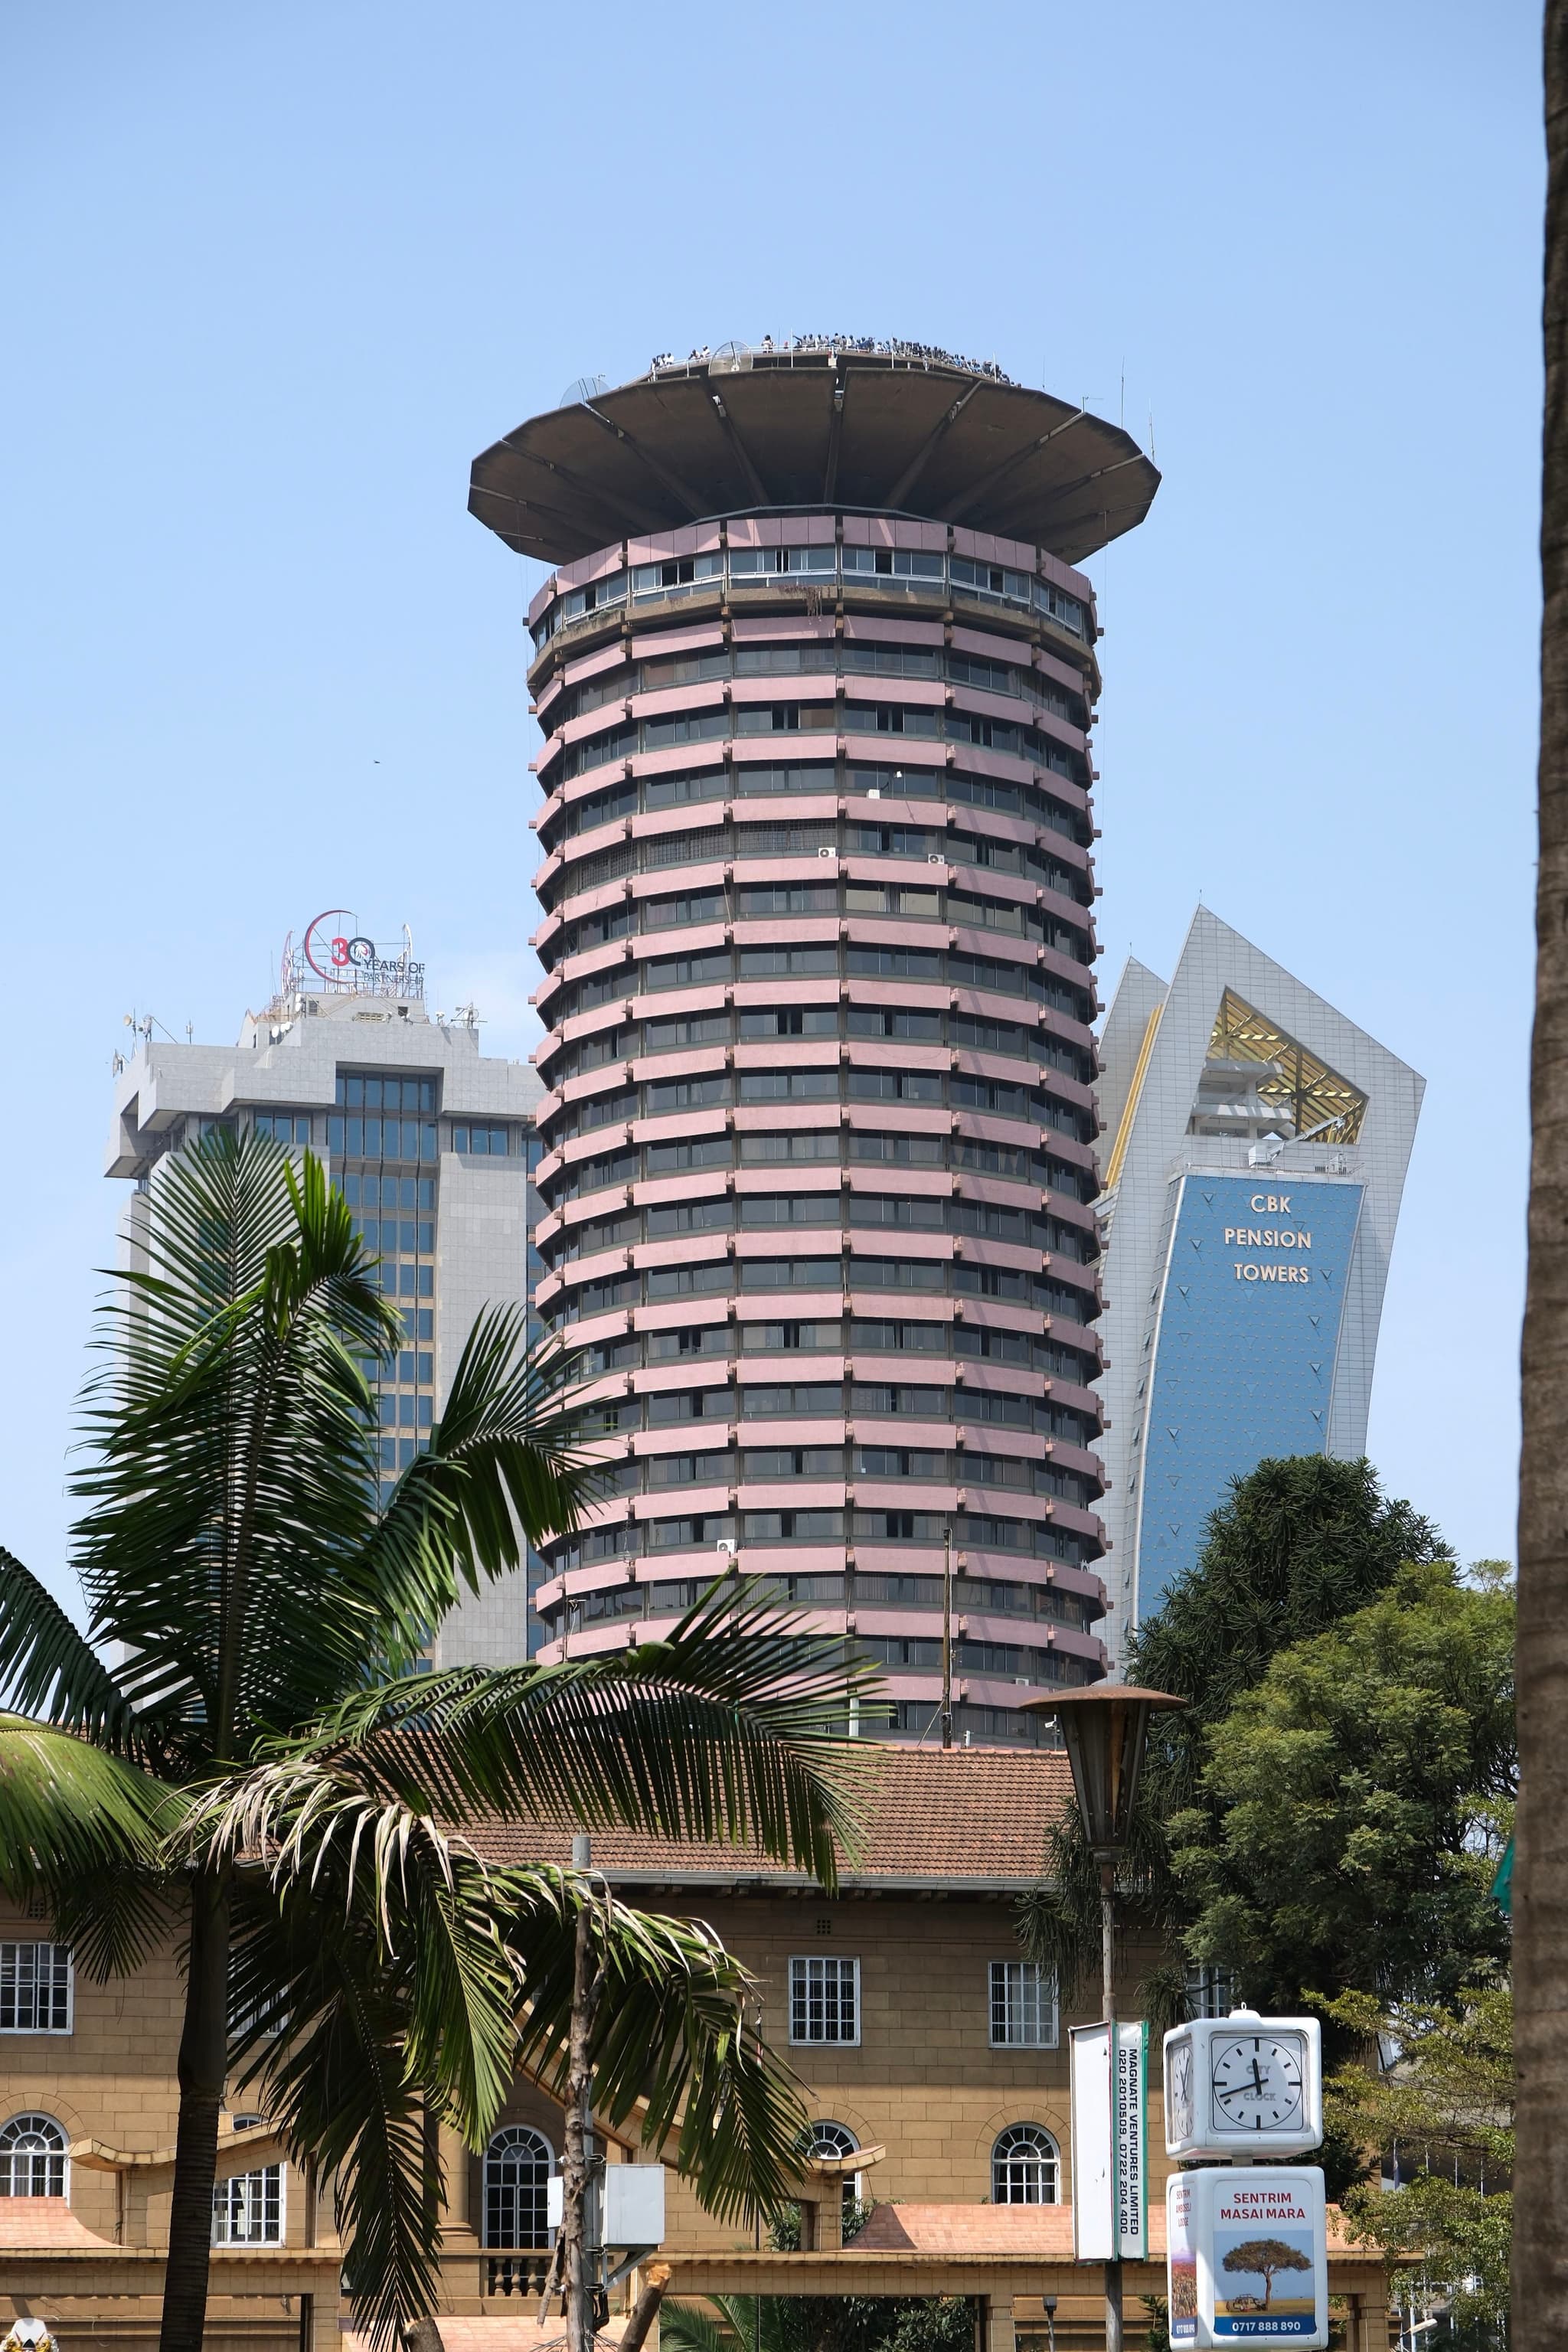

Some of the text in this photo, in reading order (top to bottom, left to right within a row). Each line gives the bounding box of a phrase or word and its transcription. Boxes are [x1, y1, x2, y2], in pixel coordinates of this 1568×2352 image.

[364, 959, 425, 973] YEARS OF
[364, 972, 424, 985] PARTNERSHIP
[1250, 1194, 1291, 1214] CBK
[1225, 1227, 1311, 1249] PENSION
[1234, 1263, 1309, 1283] TOWERS
[1246, 2065, 1271, 2075] CTY
[1243, 2092, 1276, 2102] CLOCK
[1118, 2050, 1129, 2234] 020 2010509, 0722 204 400
[1129, 2049, 1139, 2235] MAGNATE VENTURES LIMITED
[1233, 2193, 1292, 2203] SENTRIM
[1220, 2208, 1305, 2220] MASAI MARA
[1232, 2321, 1301, 2331] 0717 888 890
